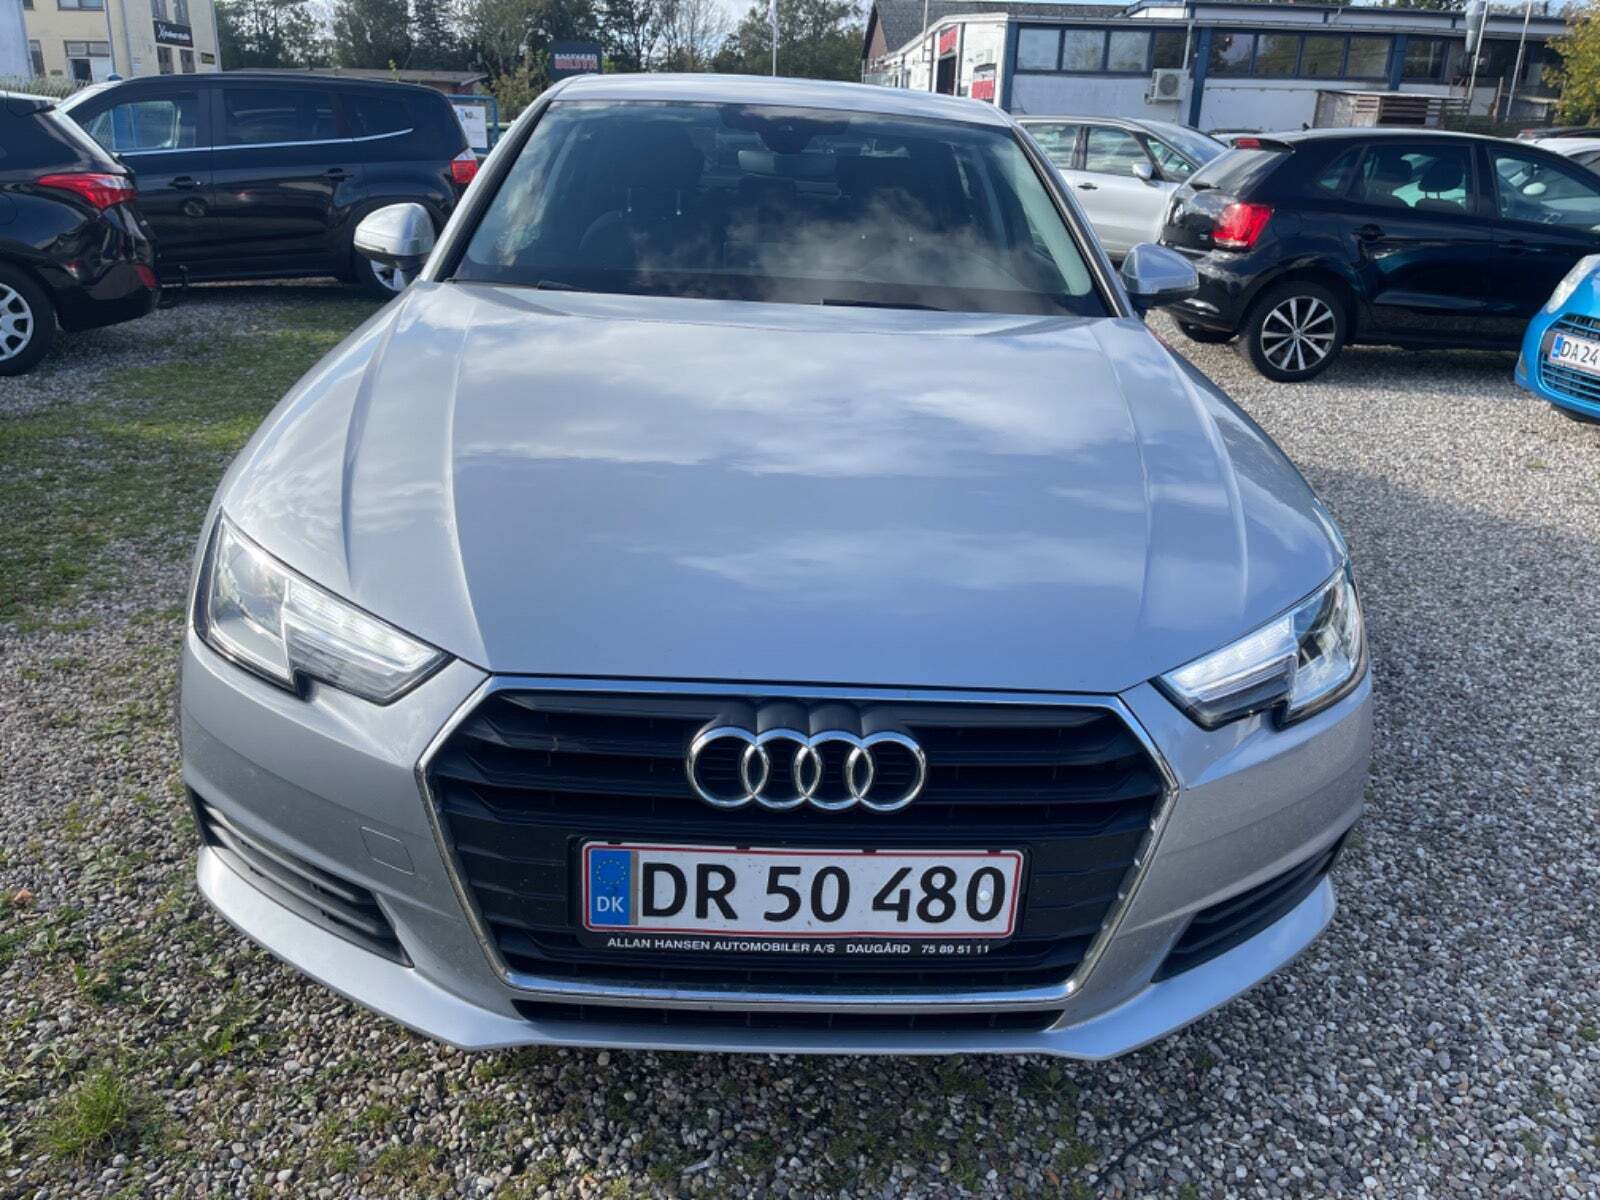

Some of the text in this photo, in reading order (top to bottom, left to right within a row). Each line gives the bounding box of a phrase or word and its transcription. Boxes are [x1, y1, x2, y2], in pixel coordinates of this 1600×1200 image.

[1560, 341, 1600, 366] DA 24
[642, 862, 1006, 923] DR 50 480
[596, 896, 624, 913] DK
[607, 937, 650, 948] ALLAN
[655, 939, 711, 950] HANSEN
[713, 941, 810, 952] AUTOMOBILER
[813, 943, 836, 953] A/S
[846, 942, 911, 954] DAUGÅRD
[922, 944, 936, 954] 75
[957, 944, 971, 954] 51
[976, 944, 990, 954] 11
